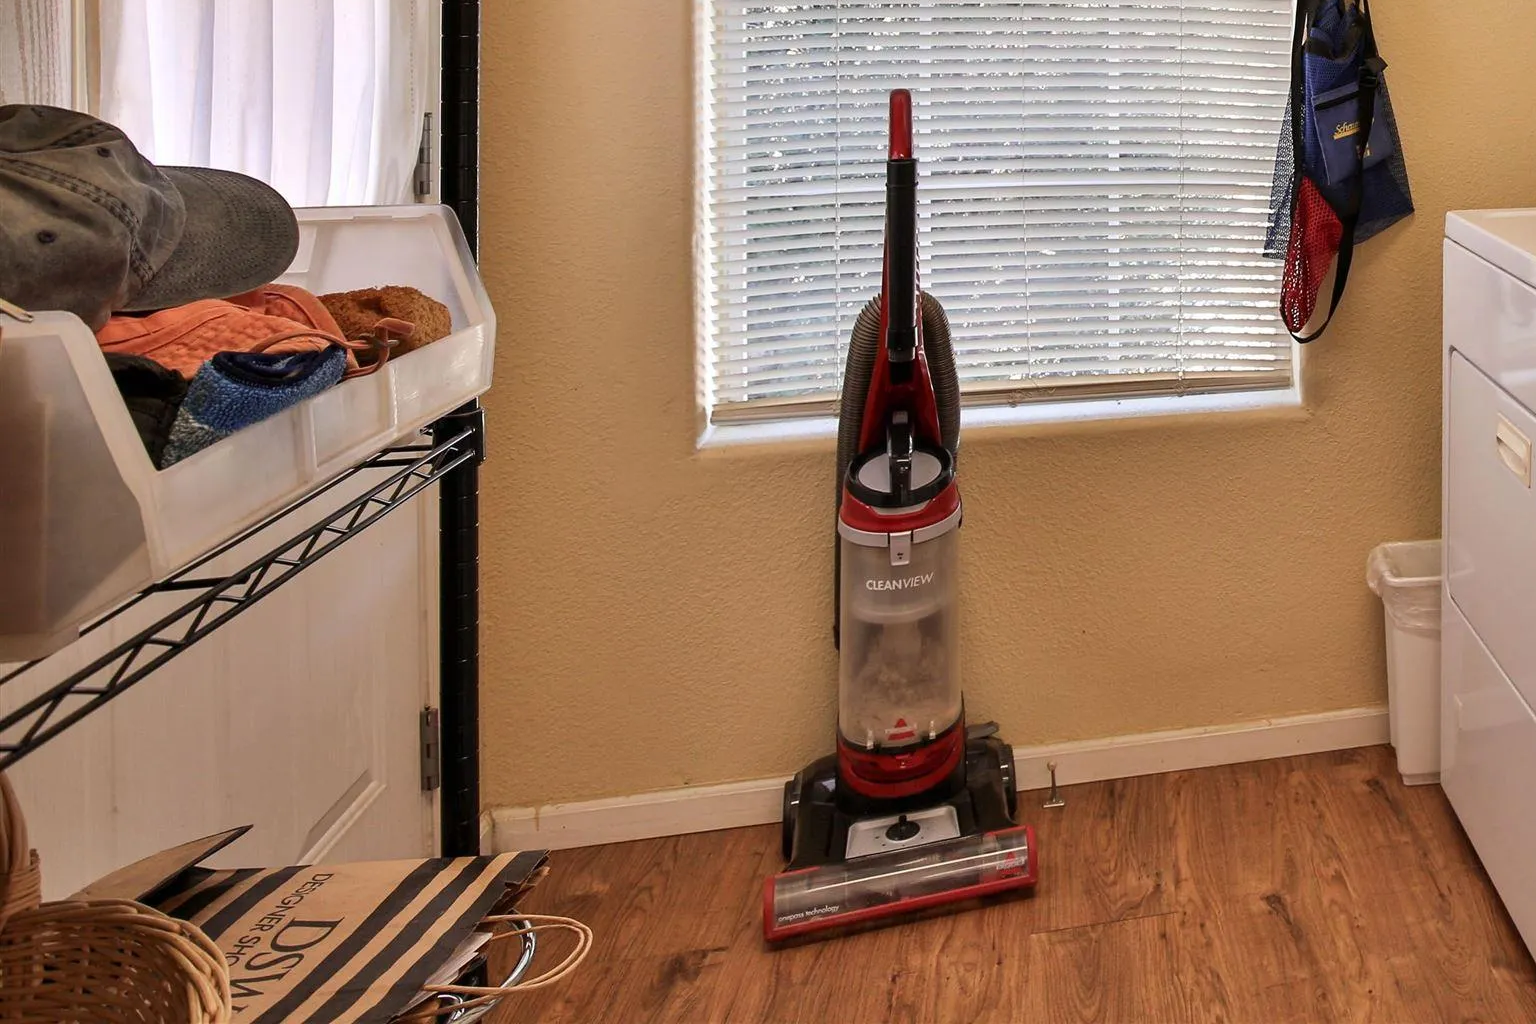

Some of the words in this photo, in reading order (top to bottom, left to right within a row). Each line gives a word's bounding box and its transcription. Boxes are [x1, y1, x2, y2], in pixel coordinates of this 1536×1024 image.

[865, 571, 934, 591] CLEANVIEW
[249, 873, 335, 932] DESIGNER
[778, 912, 804, 923] onepass
[805, 904, 839, 917] technology
